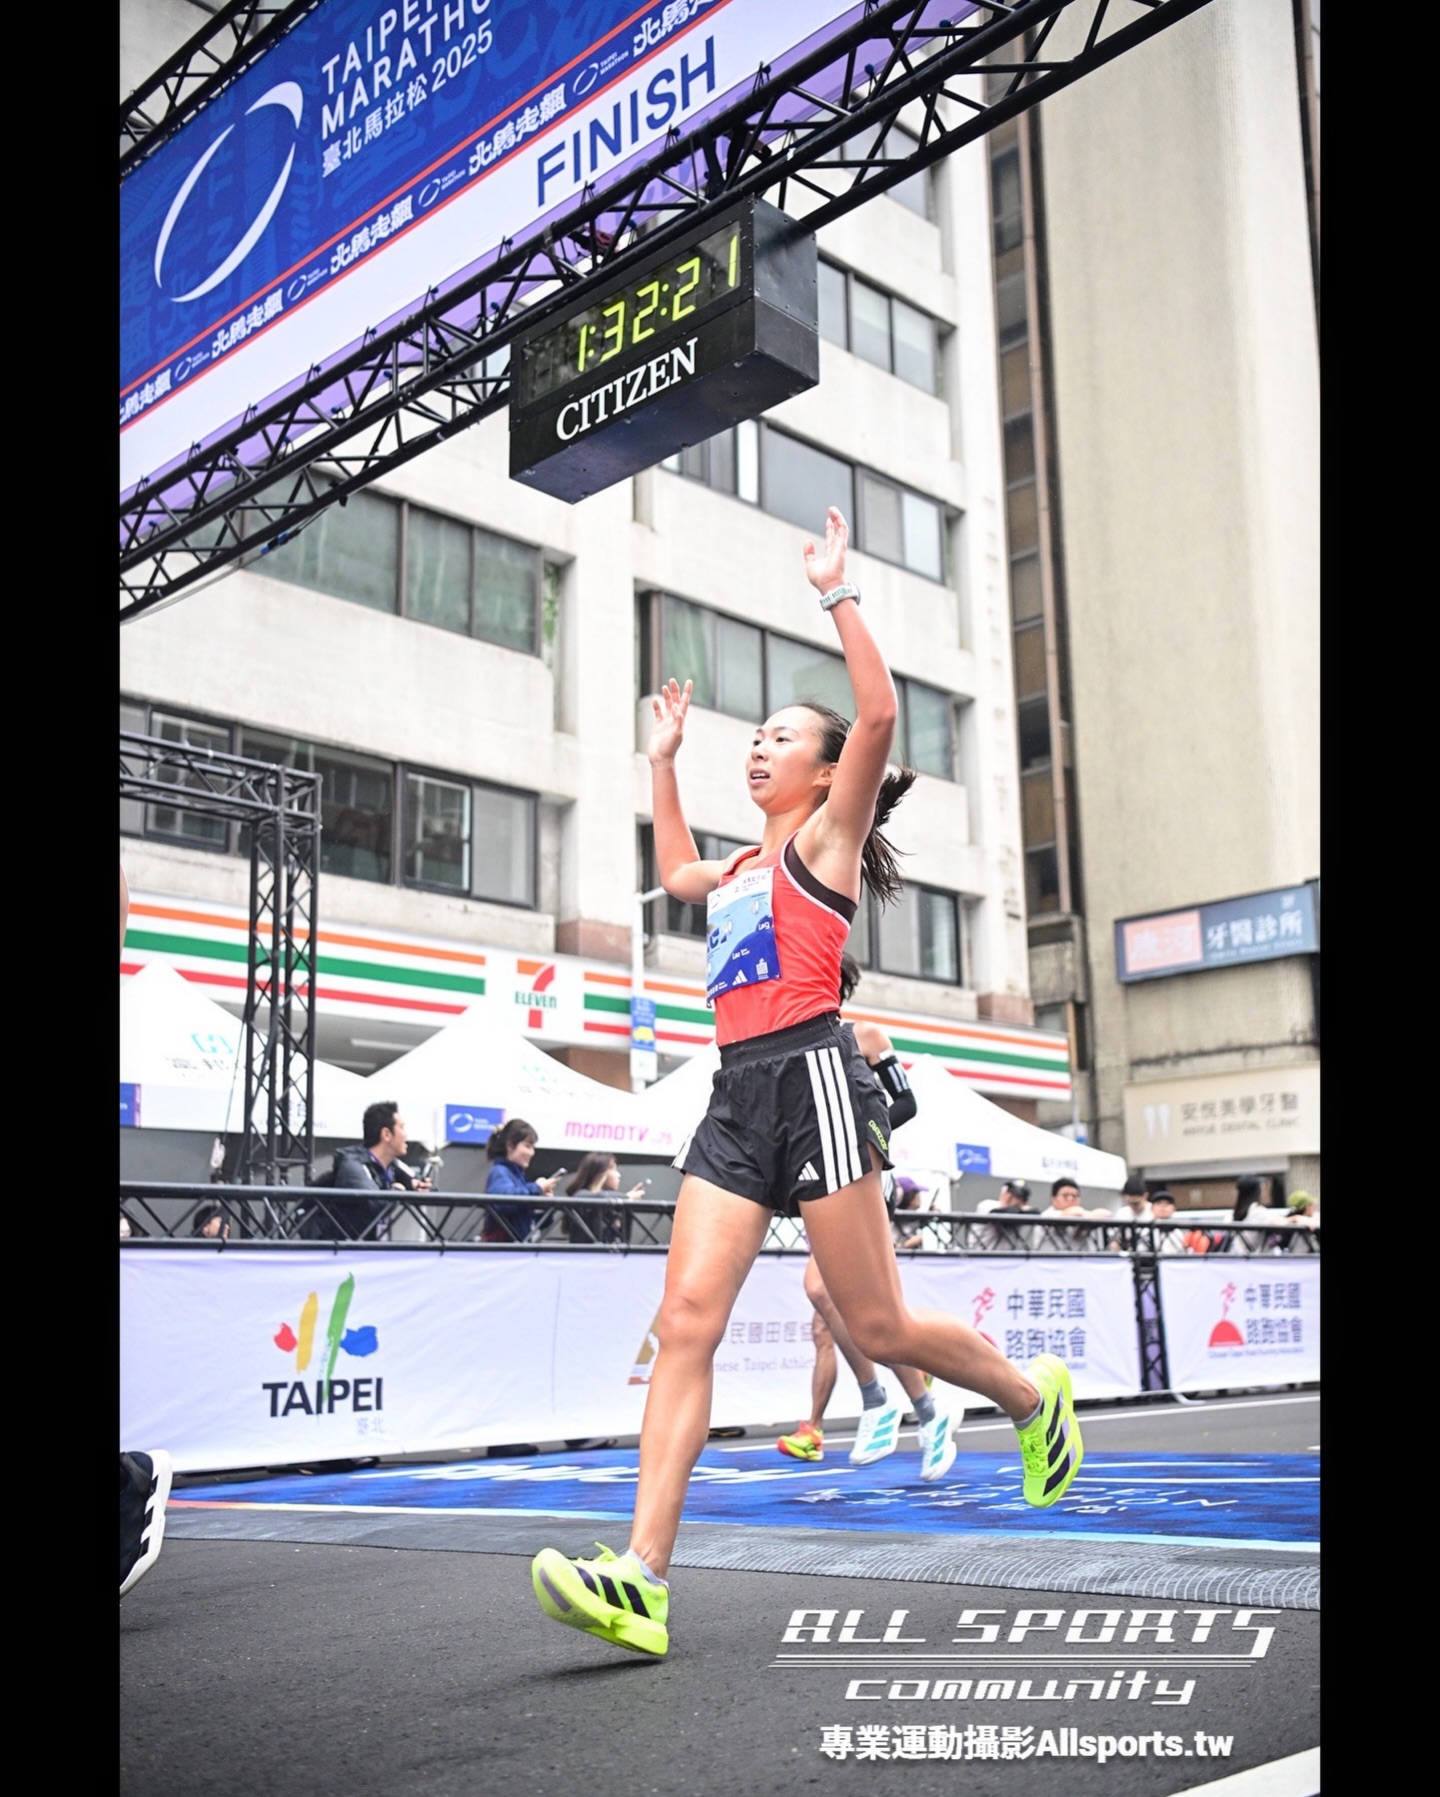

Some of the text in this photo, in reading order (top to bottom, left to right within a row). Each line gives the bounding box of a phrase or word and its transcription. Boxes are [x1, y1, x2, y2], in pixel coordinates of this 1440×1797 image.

[322, 18, 494, 178] 臺北馬拉松 2025
[538, 34, 716, 208] FINISH
[577, 234, 738, 373] 1:32:21
[556, 336, 699, 441] CITIZEN
[1006, 1287, 1086, 1320] 中華民國
[1244, 1282, 1302, 1312] 中華民國
[1005, 1326, 1087, 1360] 路跑協會
[1245, 1315, 1303, 1345] 路跑協會
[262, 1377, 384, 1418] TAIPEI
